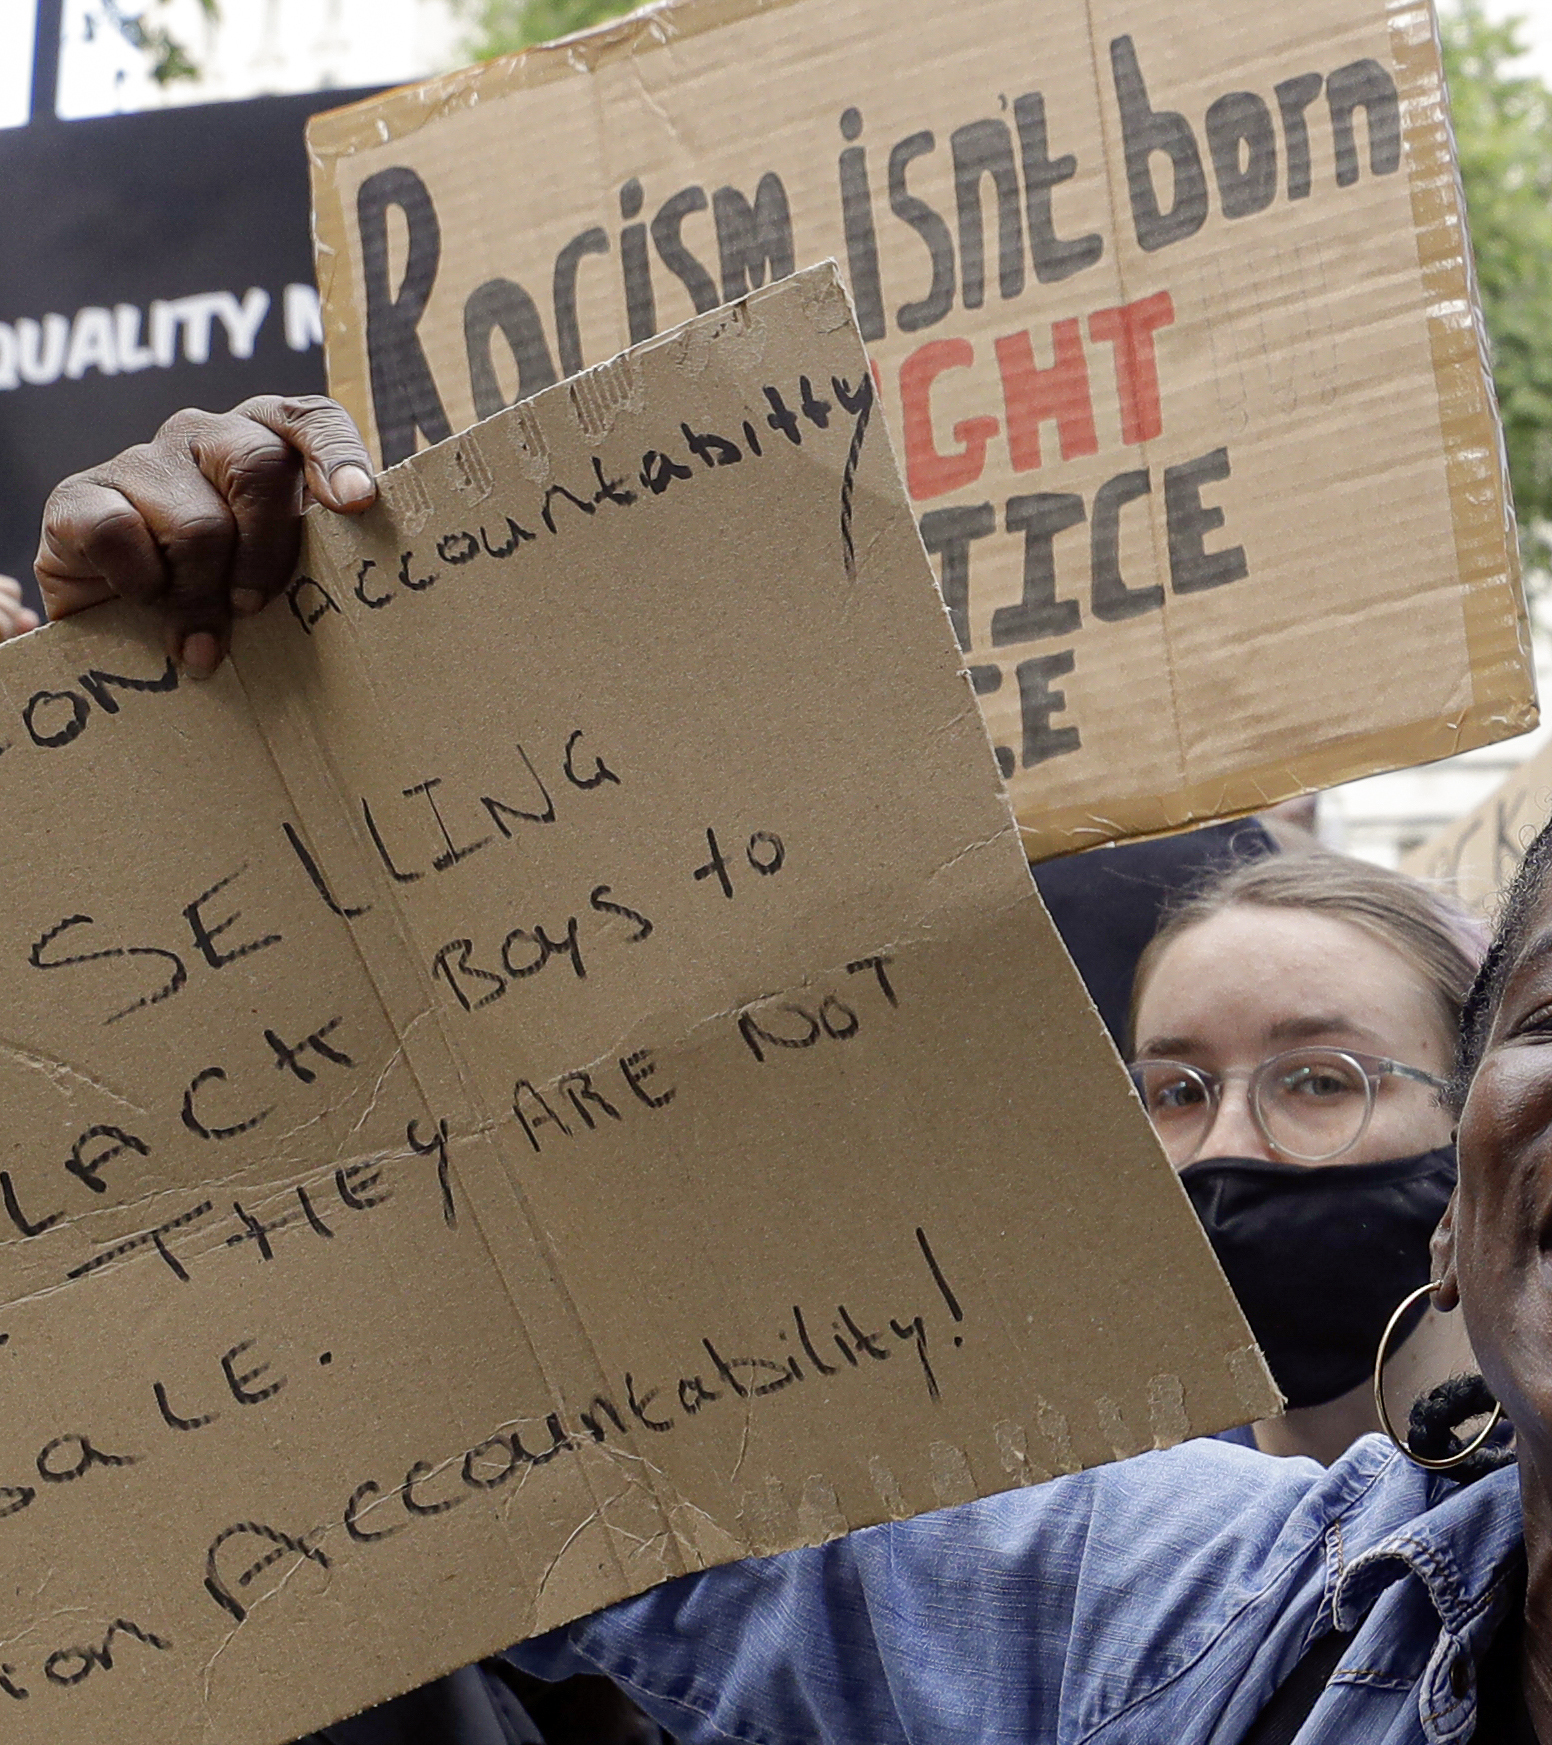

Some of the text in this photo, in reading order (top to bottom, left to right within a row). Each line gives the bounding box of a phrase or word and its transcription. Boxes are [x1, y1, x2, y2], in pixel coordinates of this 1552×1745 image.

[358, 166, 796, 466] Racism
[1109, 34, 1401, 252] born
[869, 290, 1176, 501] GHT
[28, 730, 620, 1025] SELLING
[694, 827, 785, 898] to
[513, 1049, 677, 1151] ARE
[739, 956, 898, 1061] NOT
[205, 1227, 963, 1621] Accountability!
